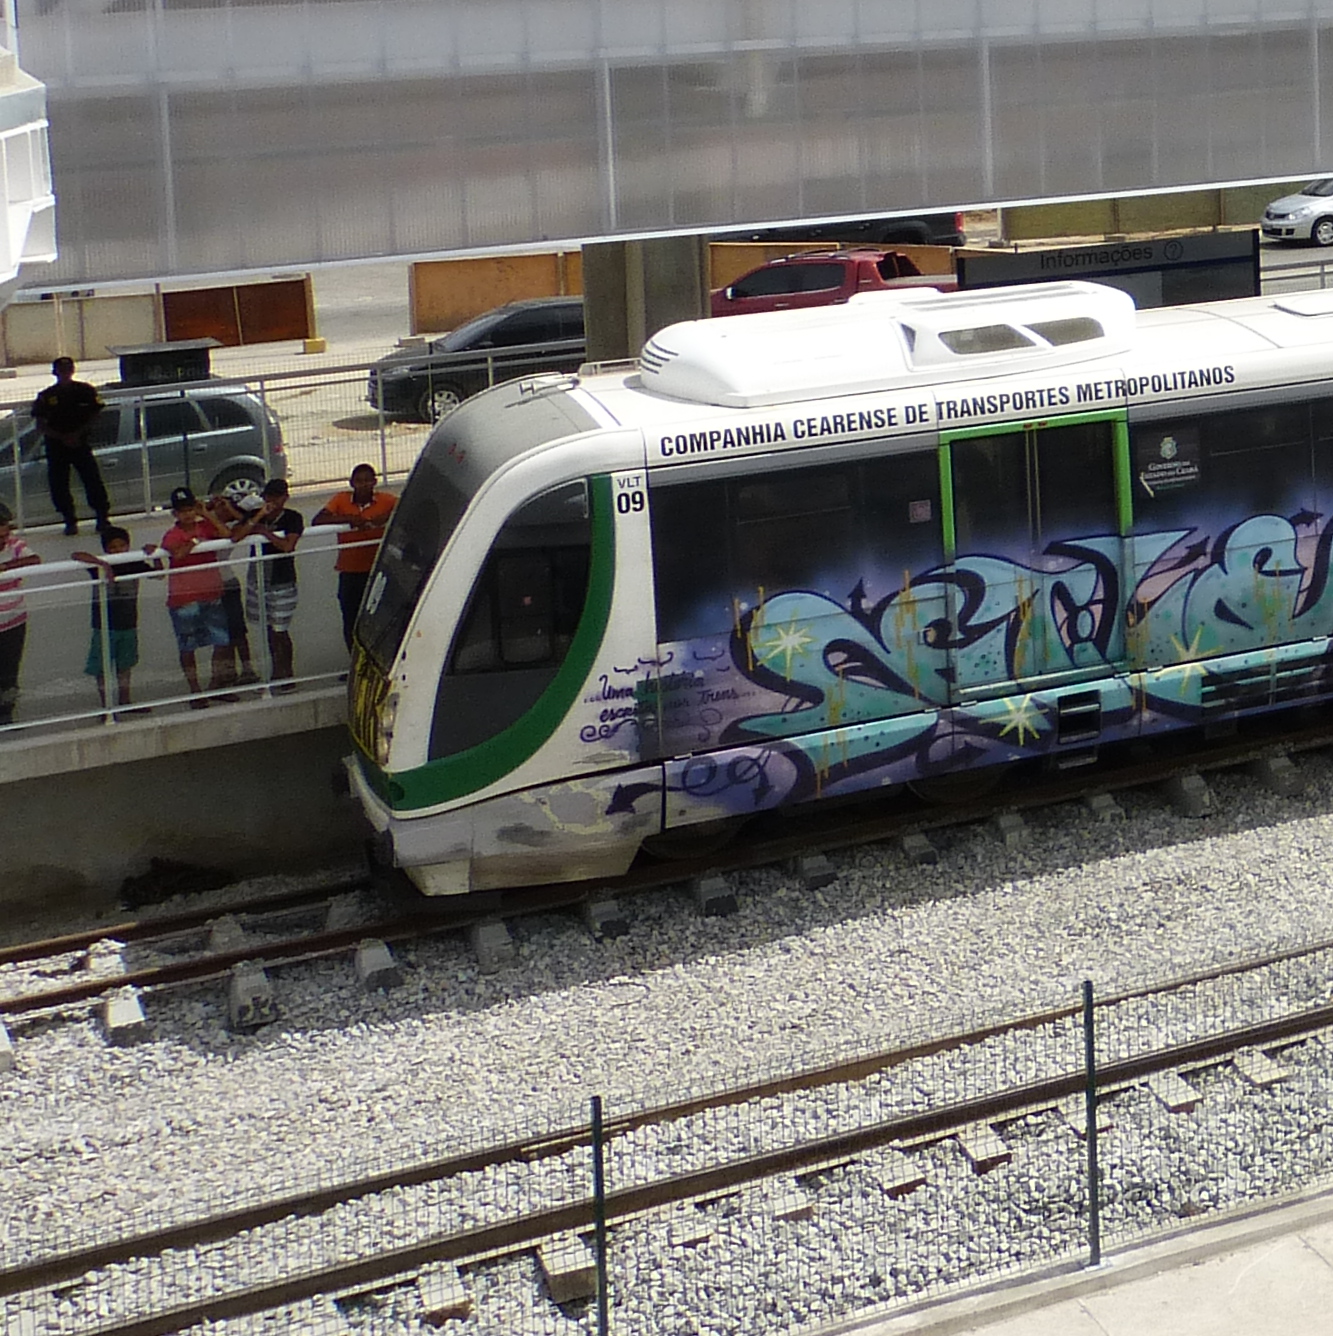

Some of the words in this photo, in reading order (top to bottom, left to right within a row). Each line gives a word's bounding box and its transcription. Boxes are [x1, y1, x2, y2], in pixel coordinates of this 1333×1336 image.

[1040, 246, 1153, 270] Informações
[660, 422, 787, 457] COMPANHIA
[793, 407, 898, 440] CEARENSE
[904, 403, 930, 424] DE
[936, 386, 1070, 420] TRANSPORTES
[1076, 365, 1236, 403] METROPOLITANOS
[617, 475, 642, 489] VLT
[617, 491, 645, 514] 09
